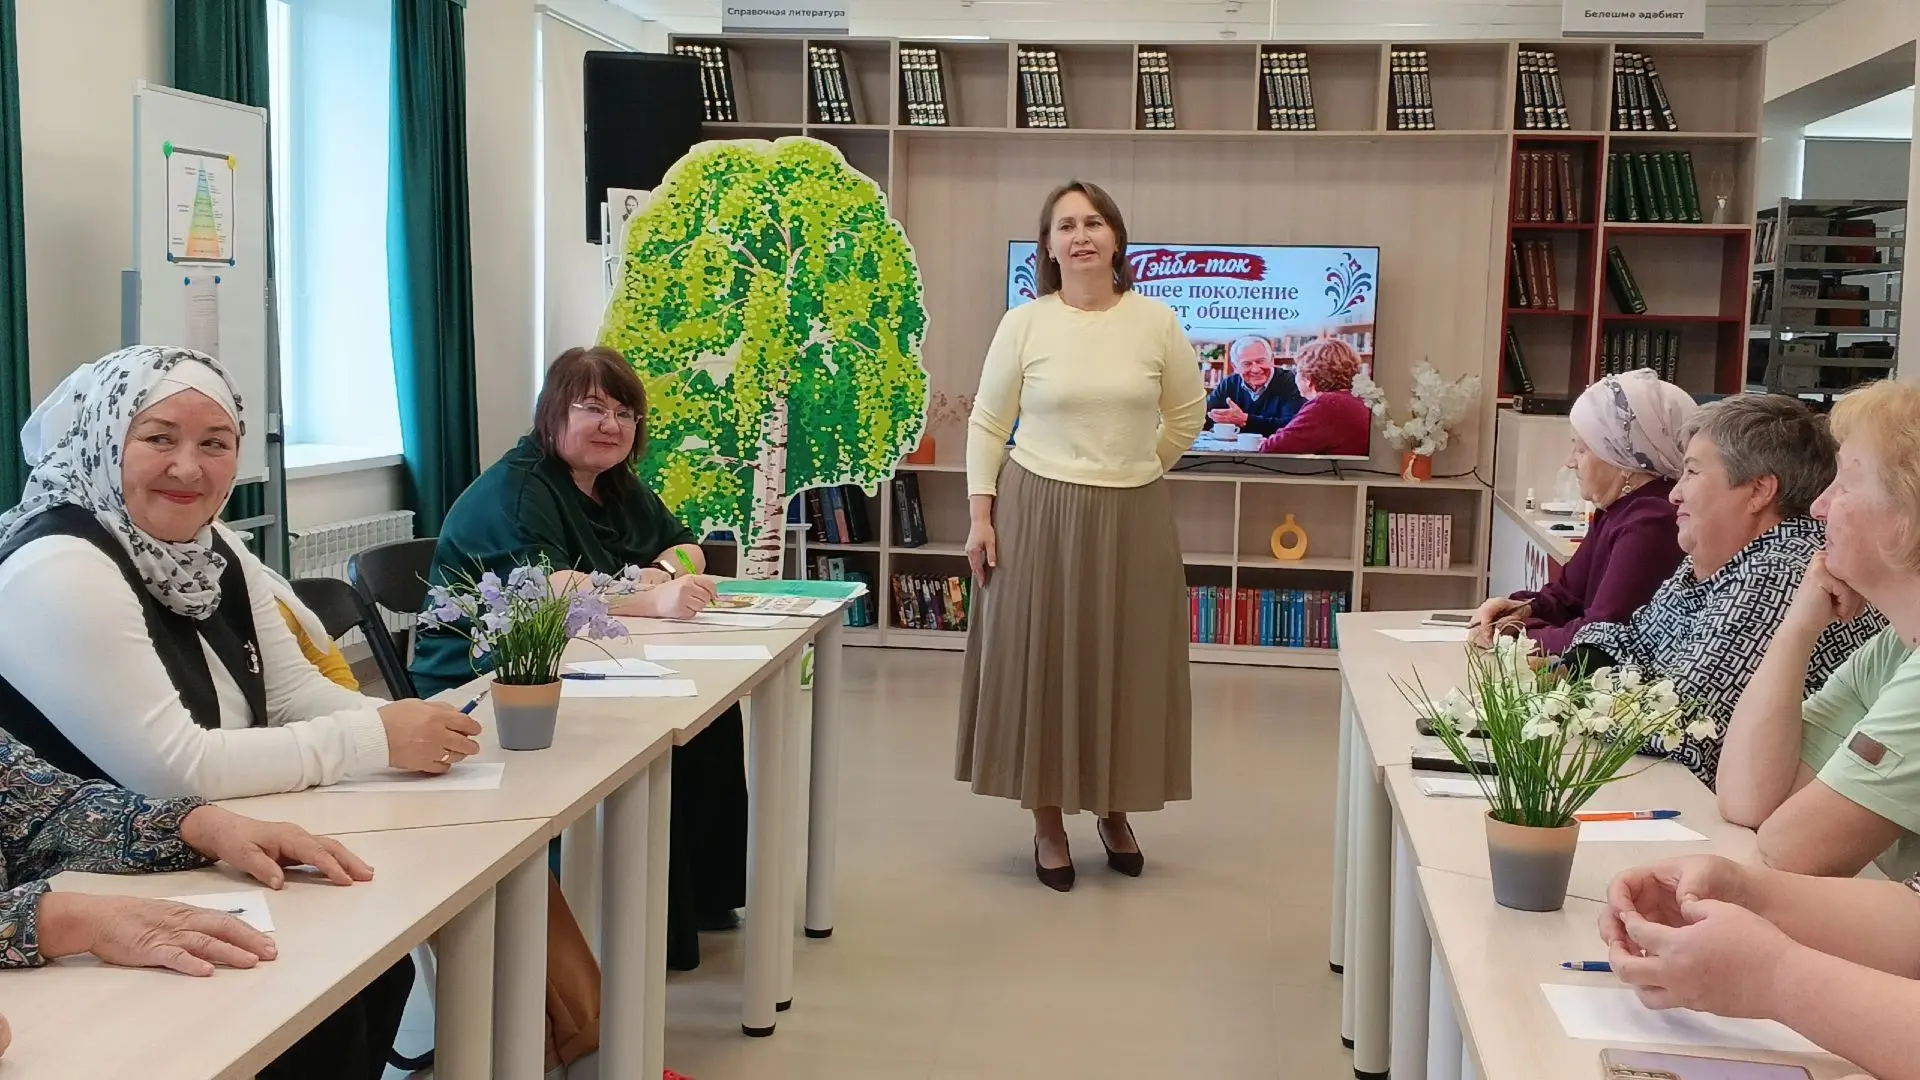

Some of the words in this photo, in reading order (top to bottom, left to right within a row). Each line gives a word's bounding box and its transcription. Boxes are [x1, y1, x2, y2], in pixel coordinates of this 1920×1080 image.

[727, 7, 786, 16] Справочная
[788, 9, 845, 17] литература
[1130, 252, 1252, 280] Тэйбл-ток
[1188, 284, 1299, 300] поколение
[1196, 302, 1300, 322] общение»
